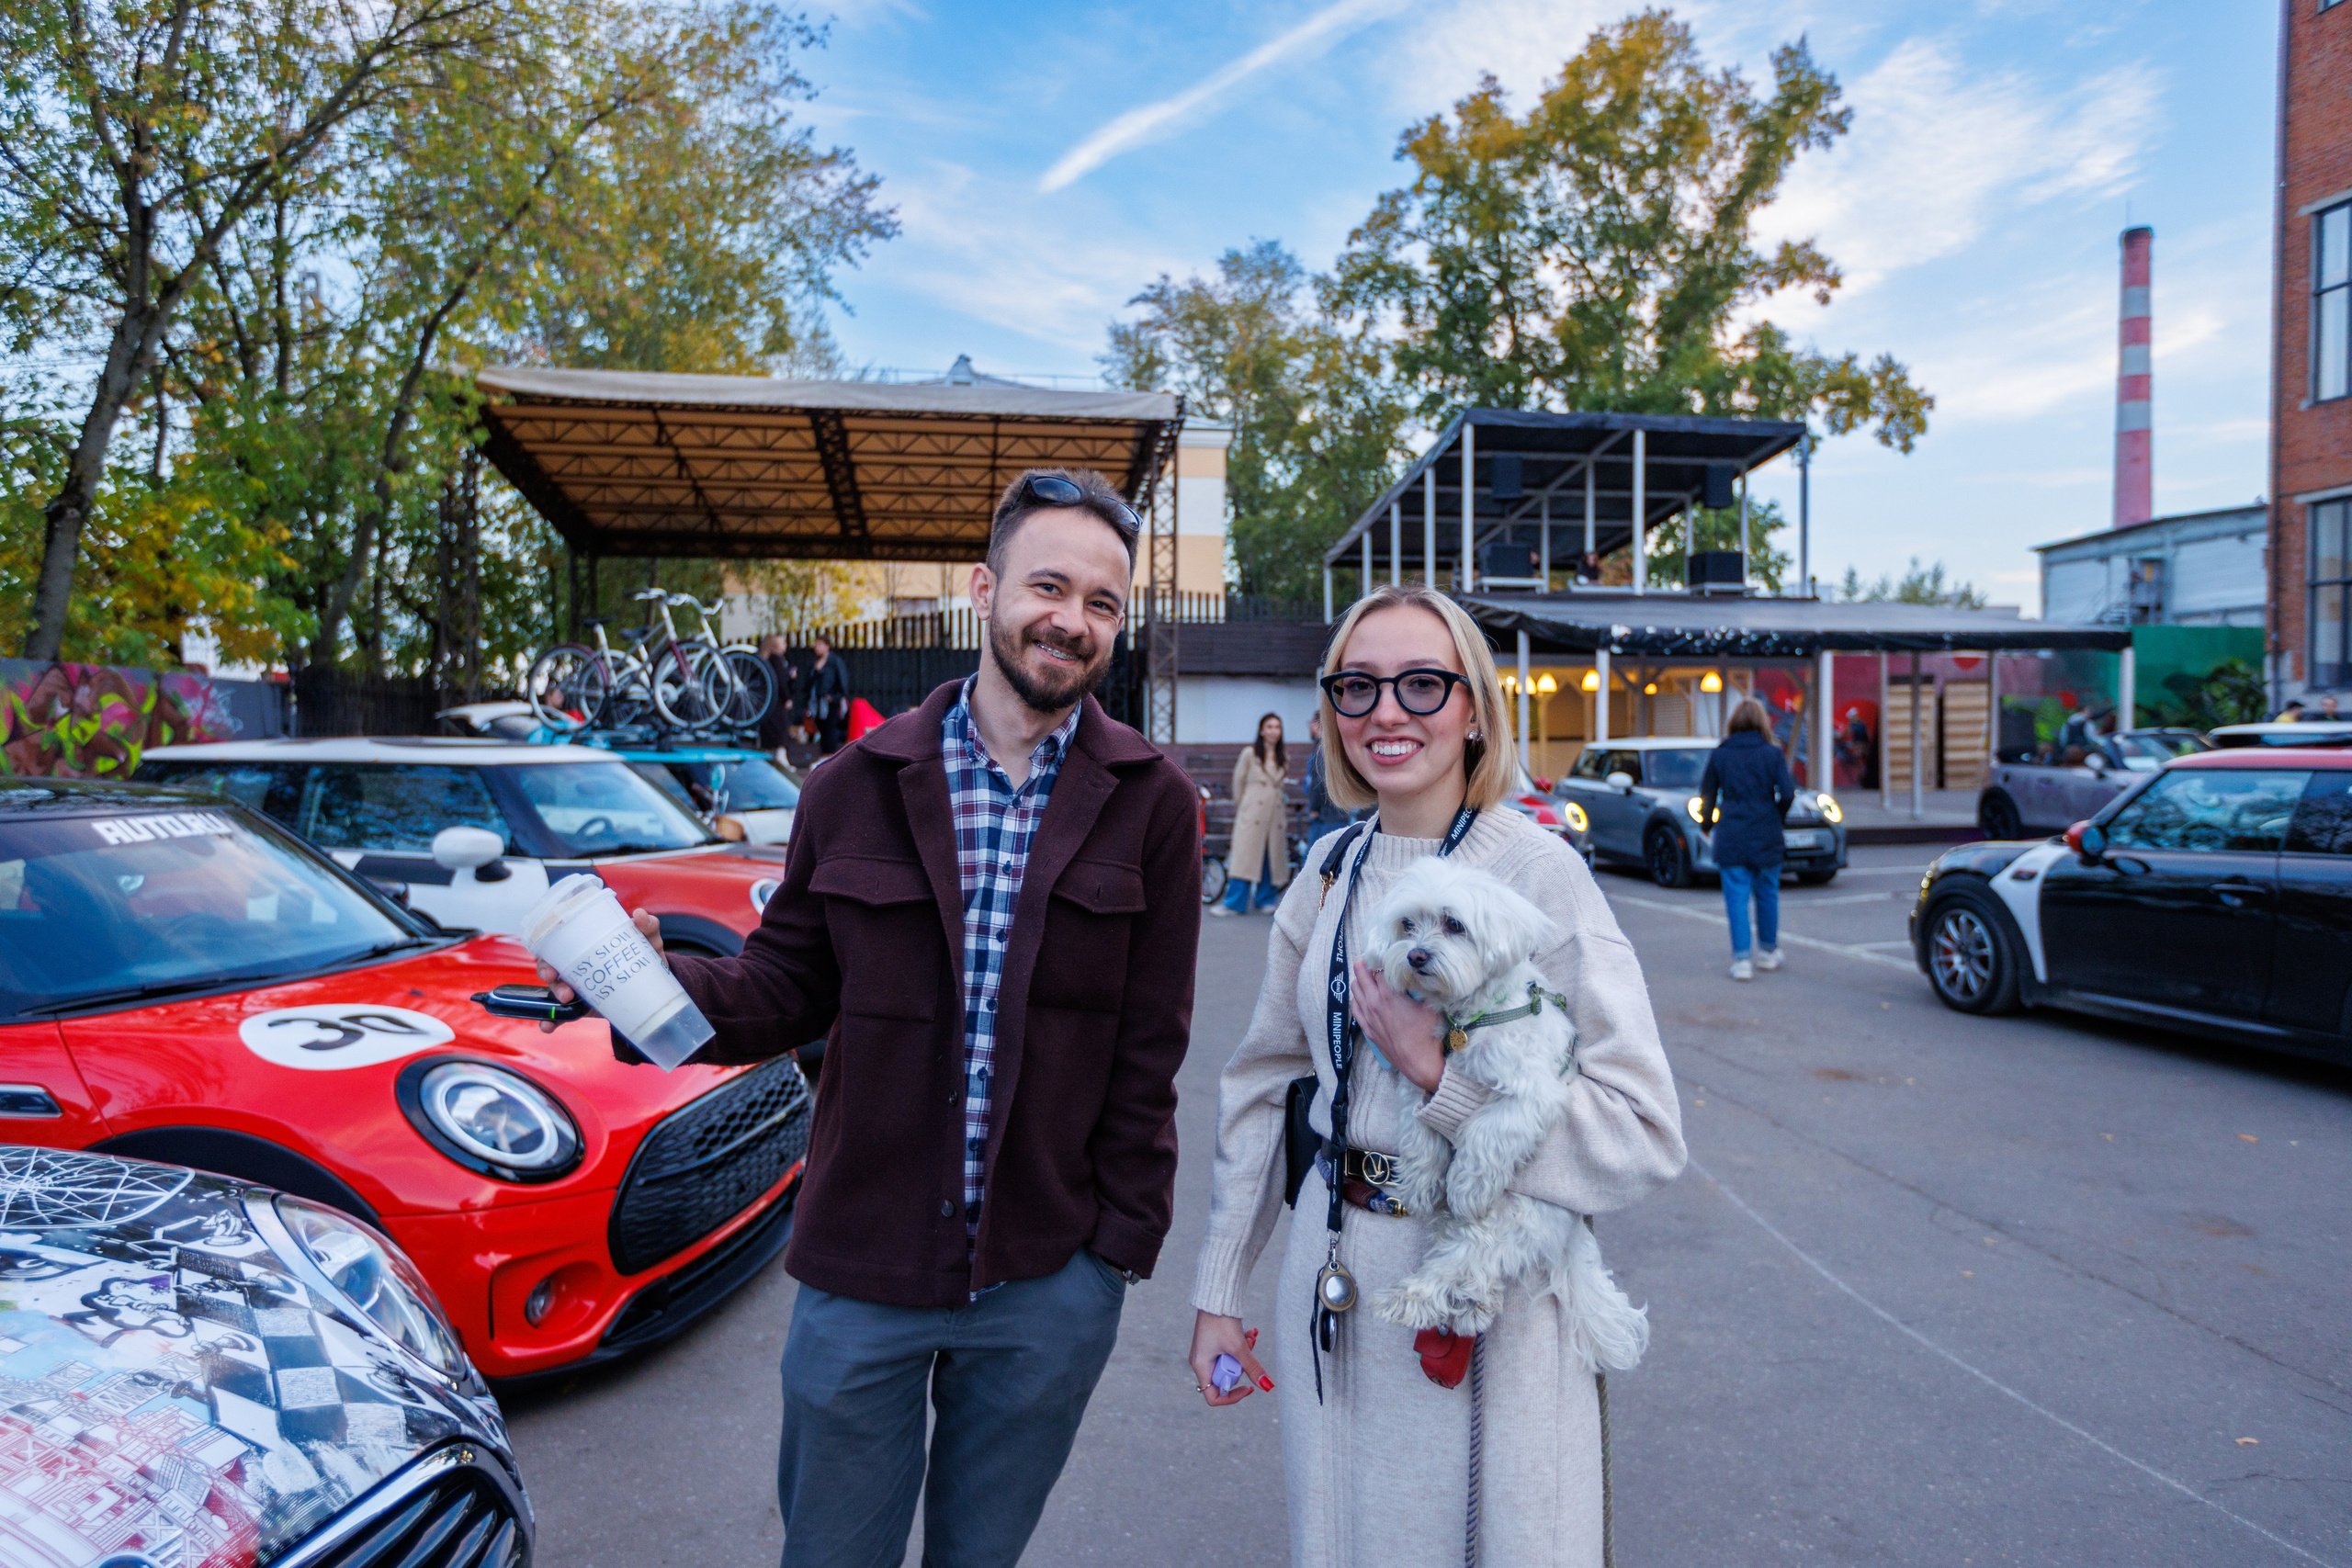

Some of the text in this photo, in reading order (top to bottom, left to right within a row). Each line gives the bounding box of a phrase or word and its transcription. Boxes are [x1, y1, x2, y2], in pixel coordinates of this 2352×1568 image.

[595, 931, 632, 959] SLOW
[584, 942, 641, 991] COFFEE
[616, 956, 651, 983] SLOW
[267, 1013, 431, 1051] 30
[1332, 1011, 1343, 1069] MINIPEOPLE
